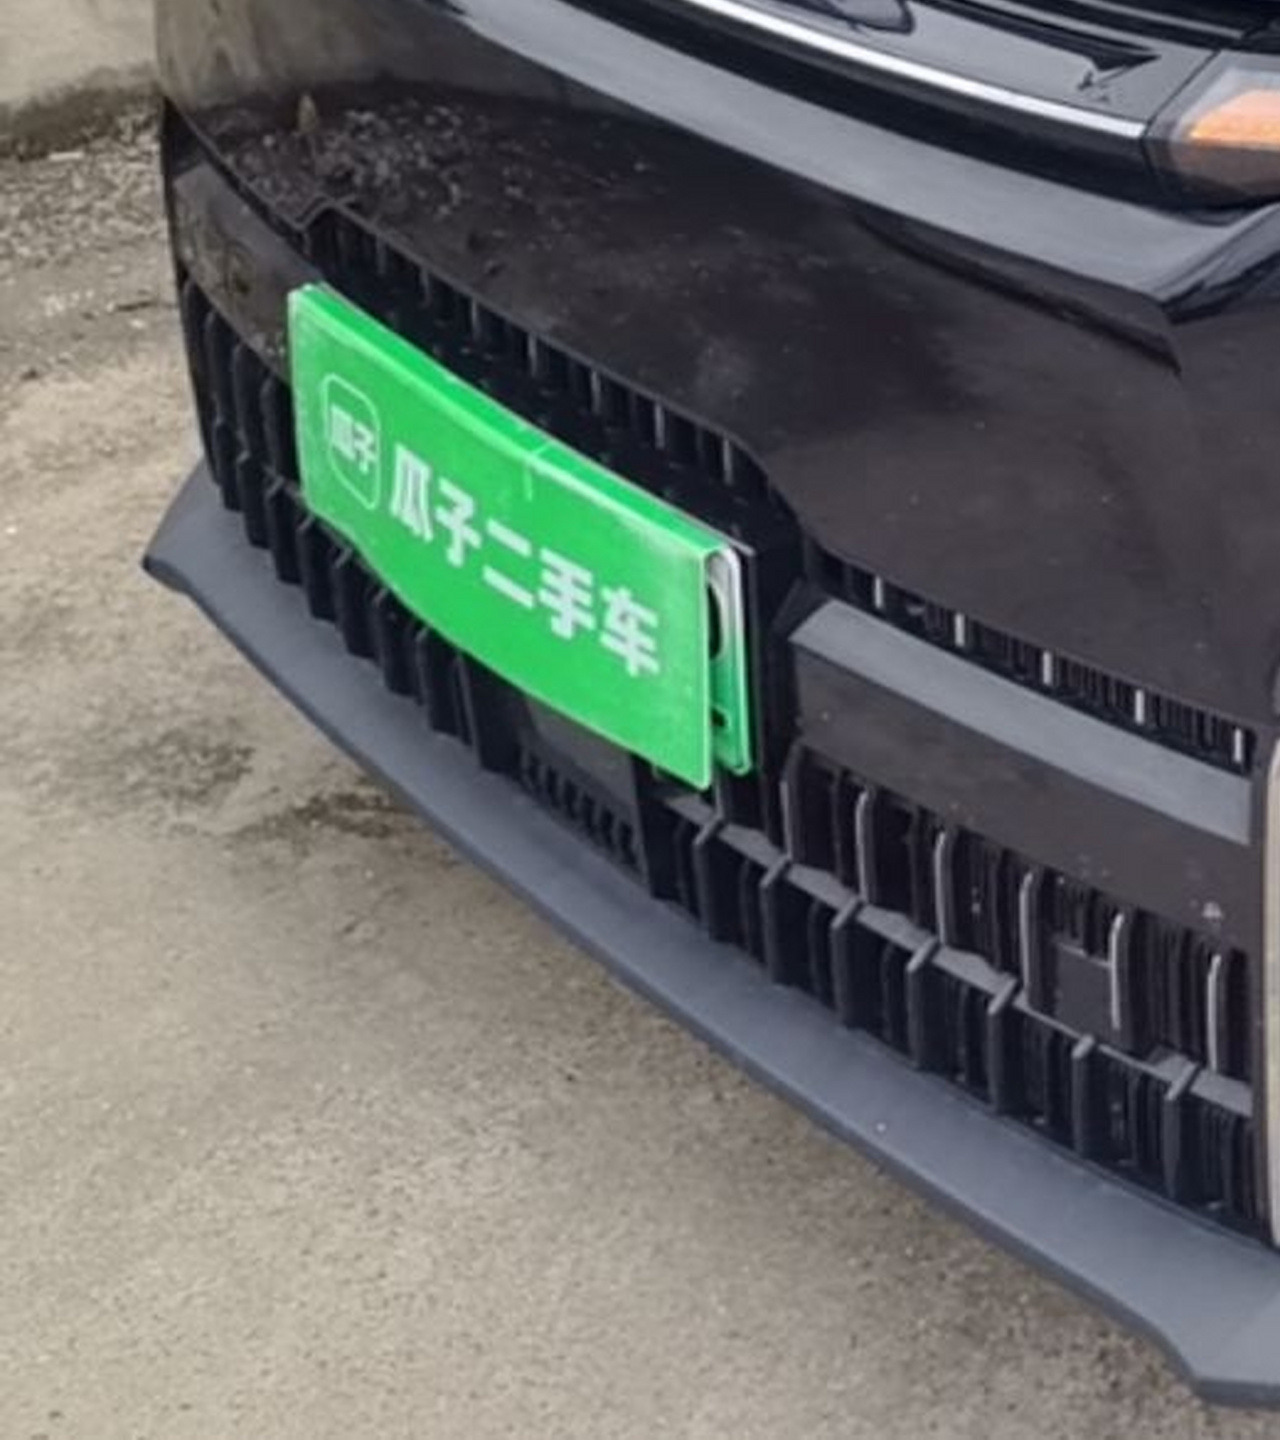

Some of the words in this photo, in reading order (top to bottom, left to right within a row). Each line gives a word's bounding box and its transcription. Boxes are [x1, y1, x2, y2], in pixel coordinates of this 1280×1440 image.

[388, 441, 660, 678] 瓜子二手车
